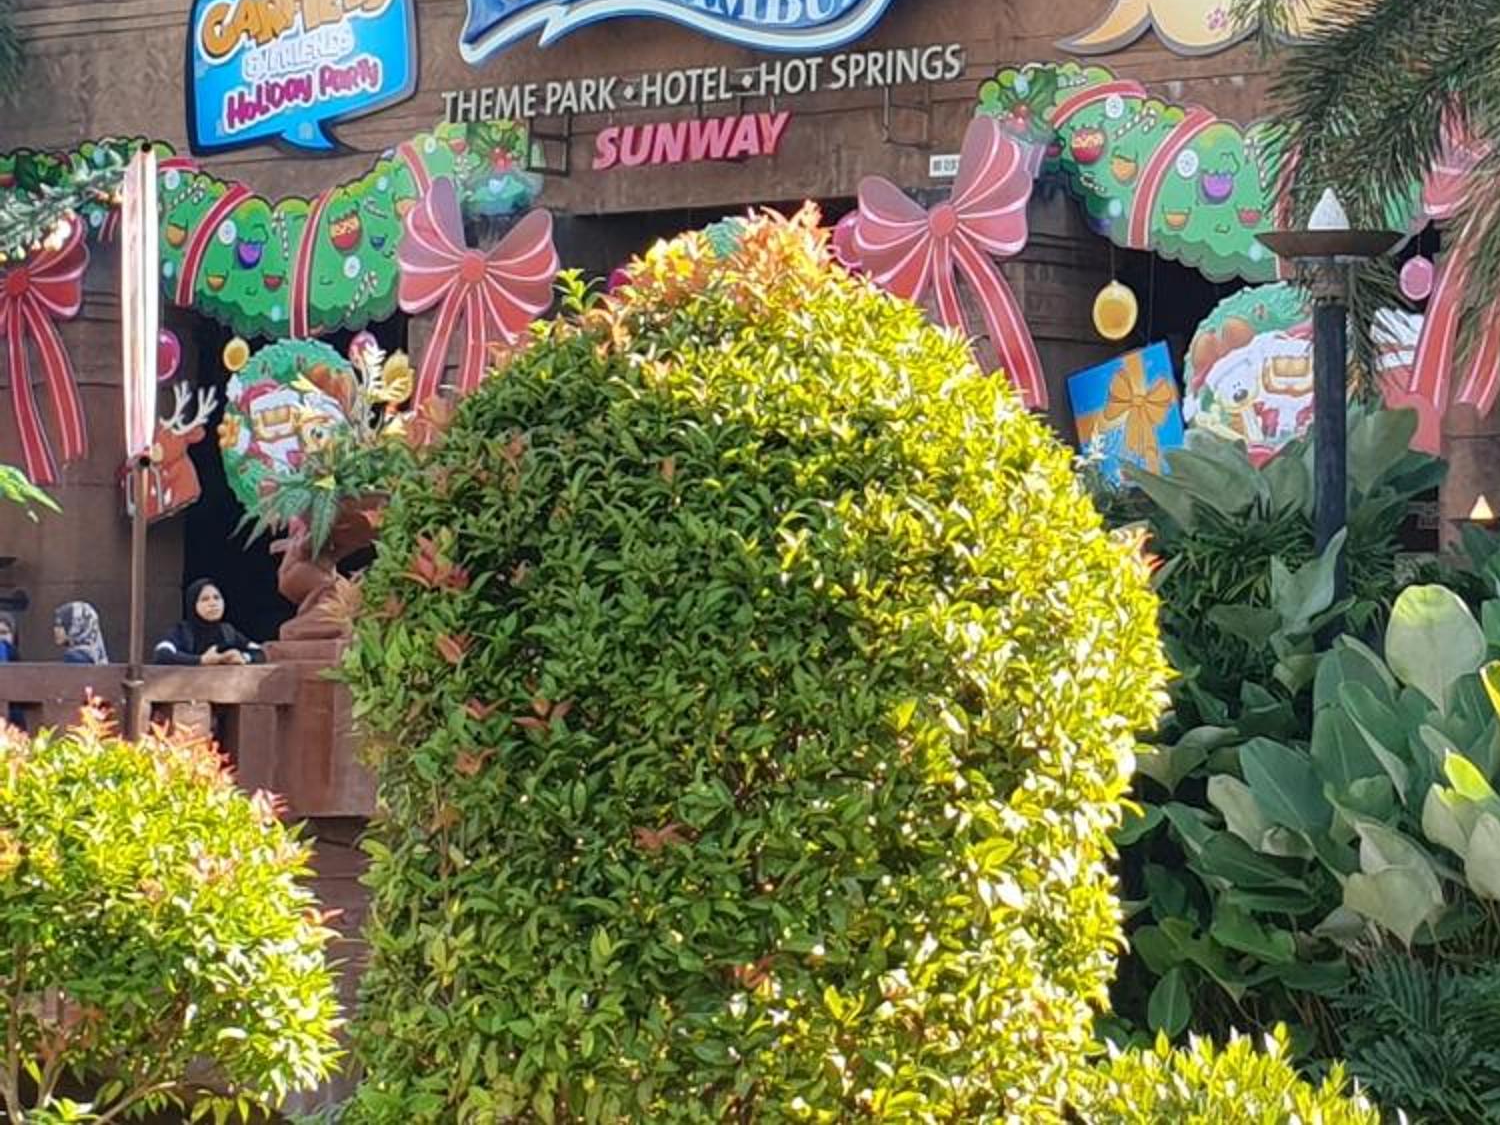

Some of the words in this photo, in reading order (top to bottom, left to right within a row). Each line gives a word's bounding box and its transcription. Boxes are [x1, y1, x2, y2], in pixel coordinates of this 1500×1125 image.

[442, 83, 538, 124] THEME
[546, 77, 617, 114] PARK
[640, 66, 734, 108] HOTEL
[760, 57, 823, 97] HOT
[831, 43, 963, 89] SPRINGS
[592, 110, 792, 173] SUNWAY
